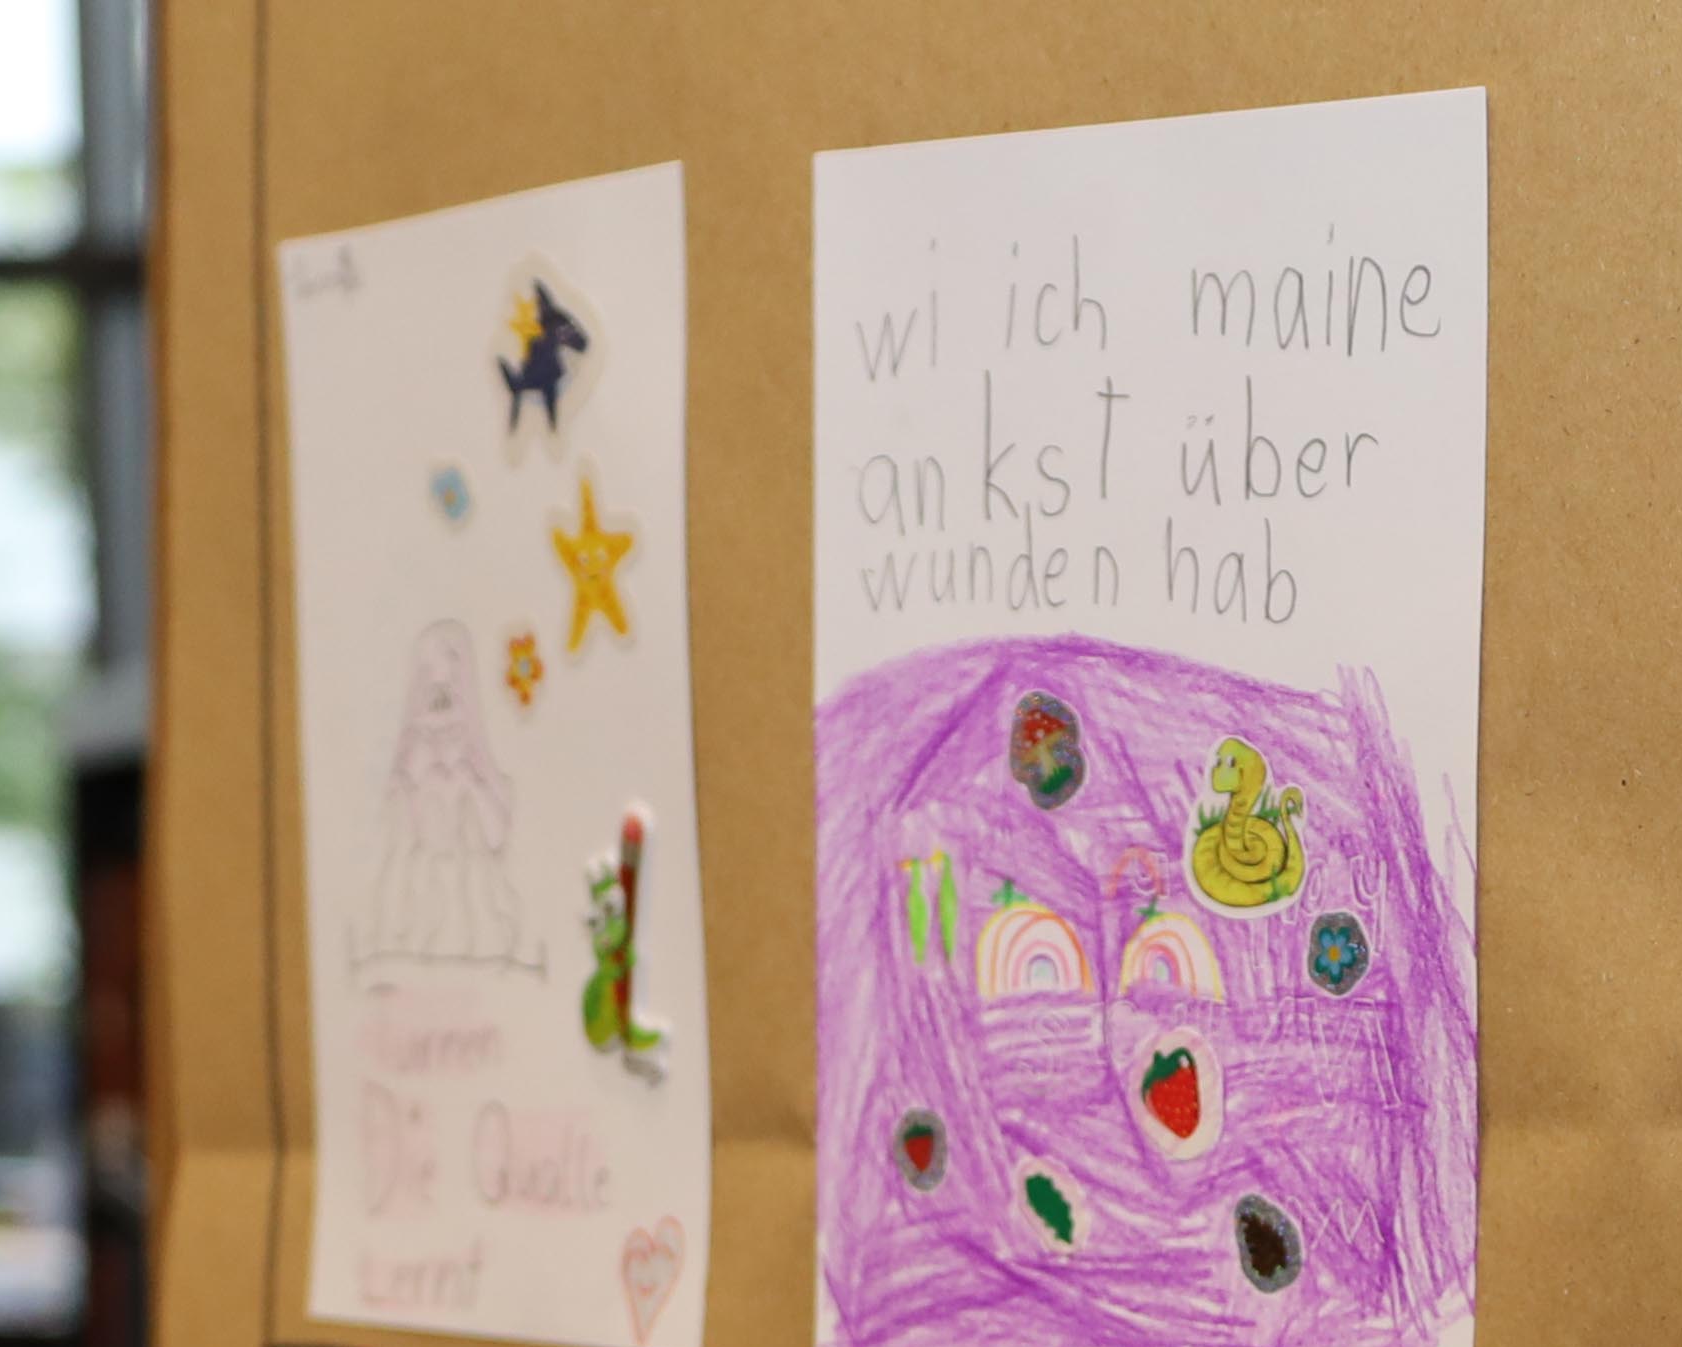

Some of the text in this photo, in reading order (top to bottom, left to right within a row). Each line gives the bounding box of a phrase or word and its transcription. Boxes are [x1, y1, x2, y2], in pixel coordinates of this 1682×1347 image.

[854, 222, 1442, 382] wi ich maine
[1180, 375, 1379, 506] über
[859, 502, 1298, 625] wunden hab
